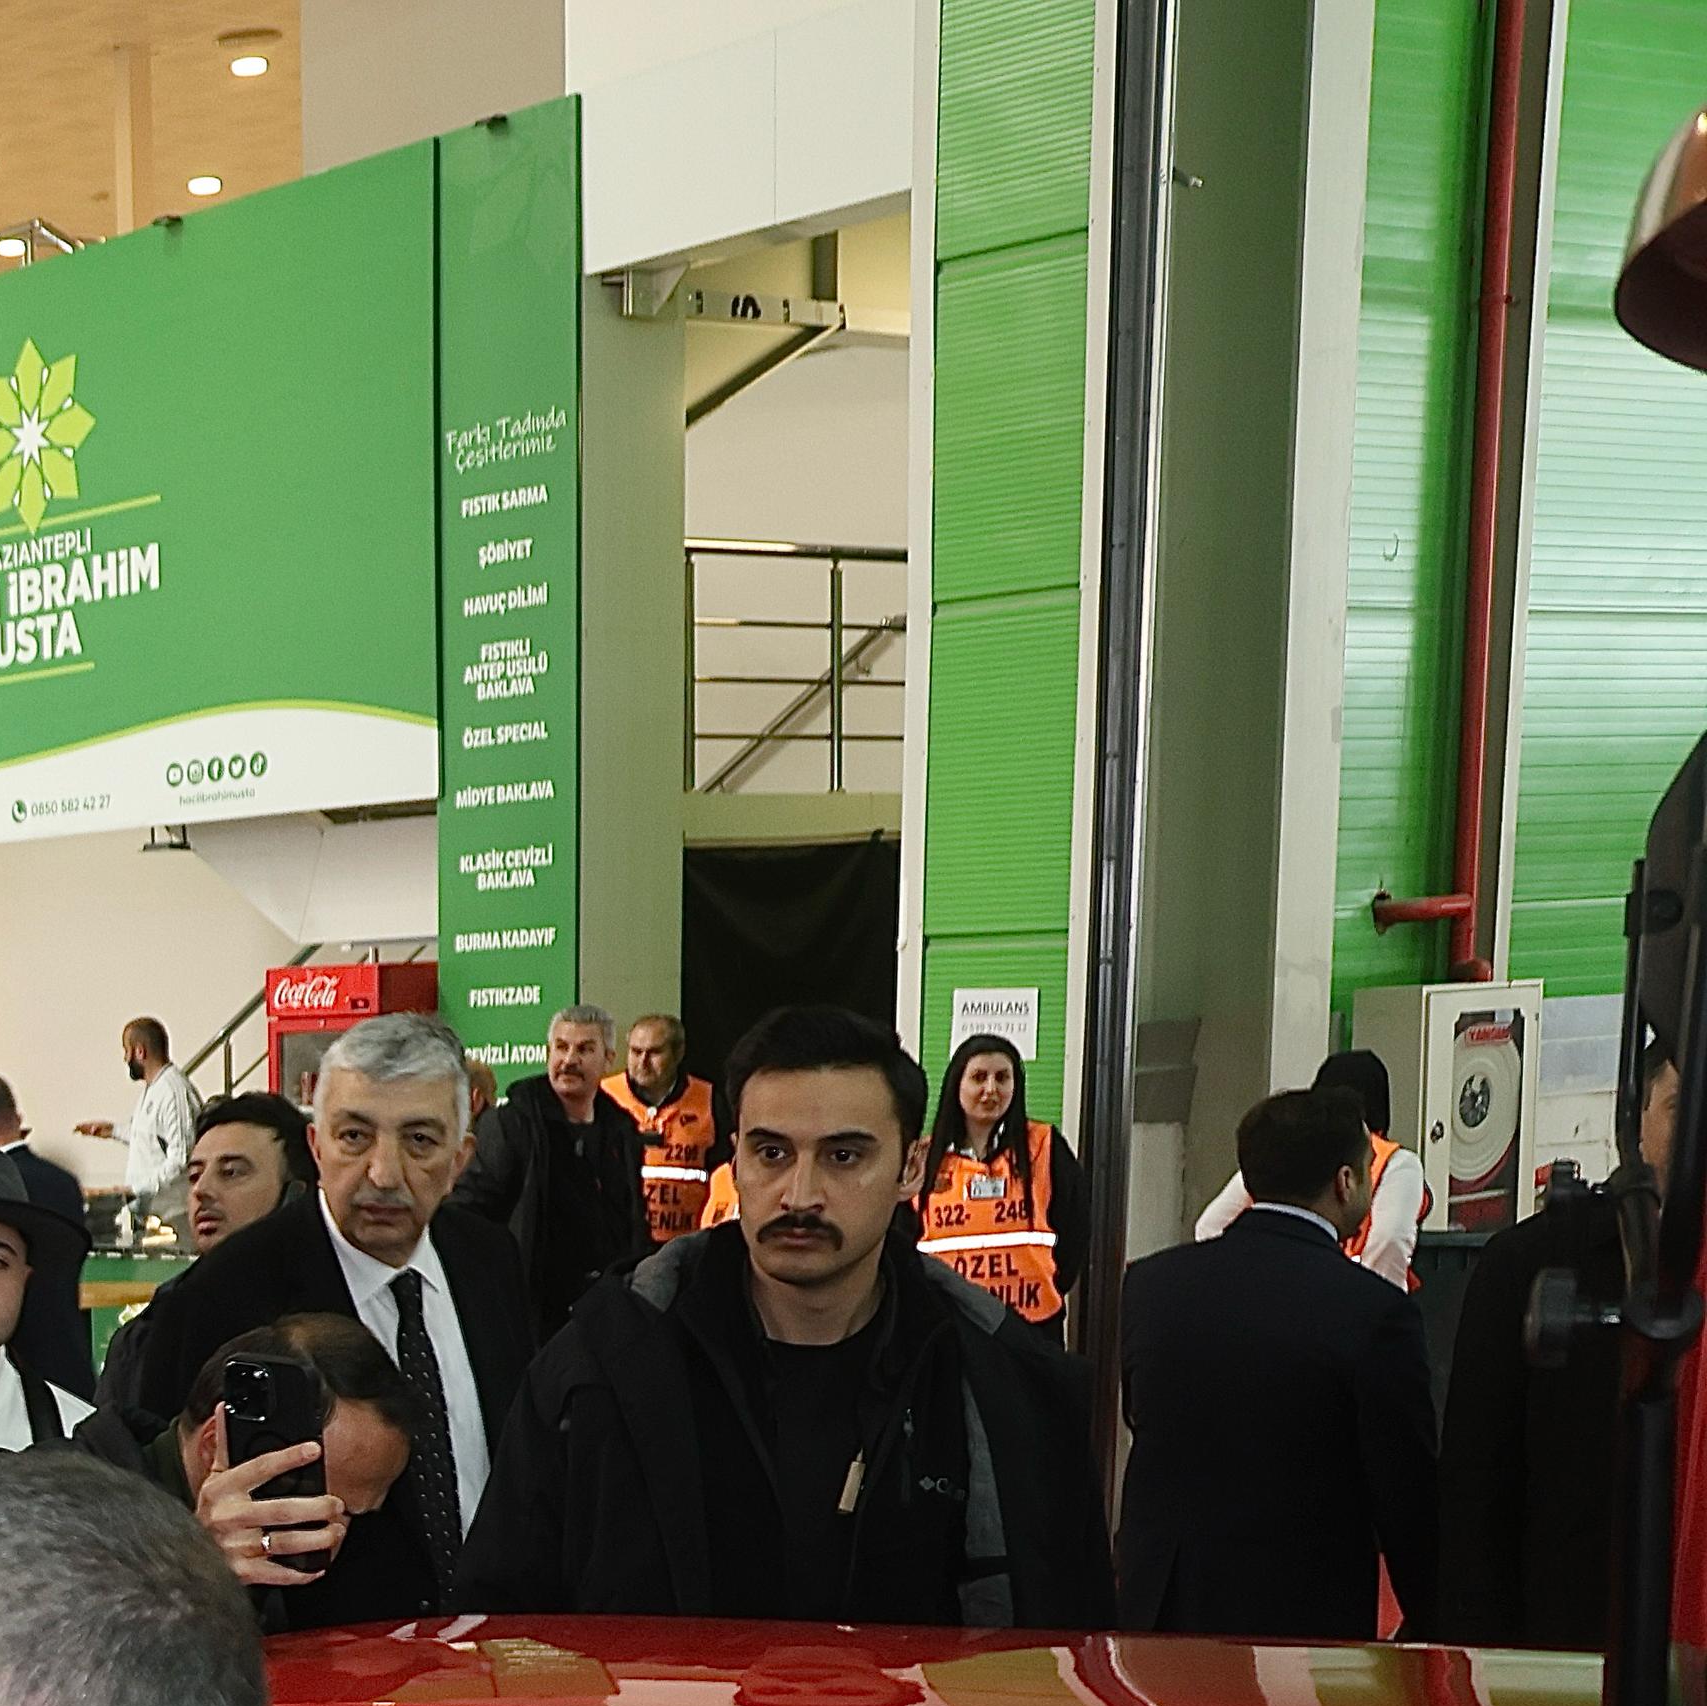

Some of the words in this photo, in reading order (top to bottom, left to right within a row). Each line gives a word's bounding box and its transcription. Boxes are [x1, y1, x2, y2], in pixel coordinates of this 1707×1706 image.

[460, 492, 500, 519] FISTIK
[501, 483, 549, 511] SARMA
[478, 537, 533, 569] ŞÖBİYET
[463, 591, 507, 617] HAVUÇ
[508, 582, 549, 610] DİLİMİ
[480, 637, 531, 662] FISTIKLI
[463, 659, 505, 685] ANTEP
[506, 650, 549, 678] USULÜ
[476, 676, 535, 702] BAKLAVA
[462, 726, 496, 749] ÖZEL
[496, 720, 549, 744] SPECIAL
[455, 785, 496, 809] MİDYE
[497, 779, 555, 804] BAKLAVA
[459, 848, 504, 873] KLASİK
[505, 843, 553, 868] CEVİZLİ
[477, 868, 535, 892] BAKLAVA
[455, 932, 501, 953] BURMA
[501, 926, 556, 949] KADAYIF
[468, 985, 541, 1008] FISTIKZADE
[961, 1001, 1030, 1017] AMBULANS
[647, 1183, 681, 1205] ZEL
[954, 1251, 1018, 1279] ÖZEL
[989, 1278, 1041, 1309] NLİK
